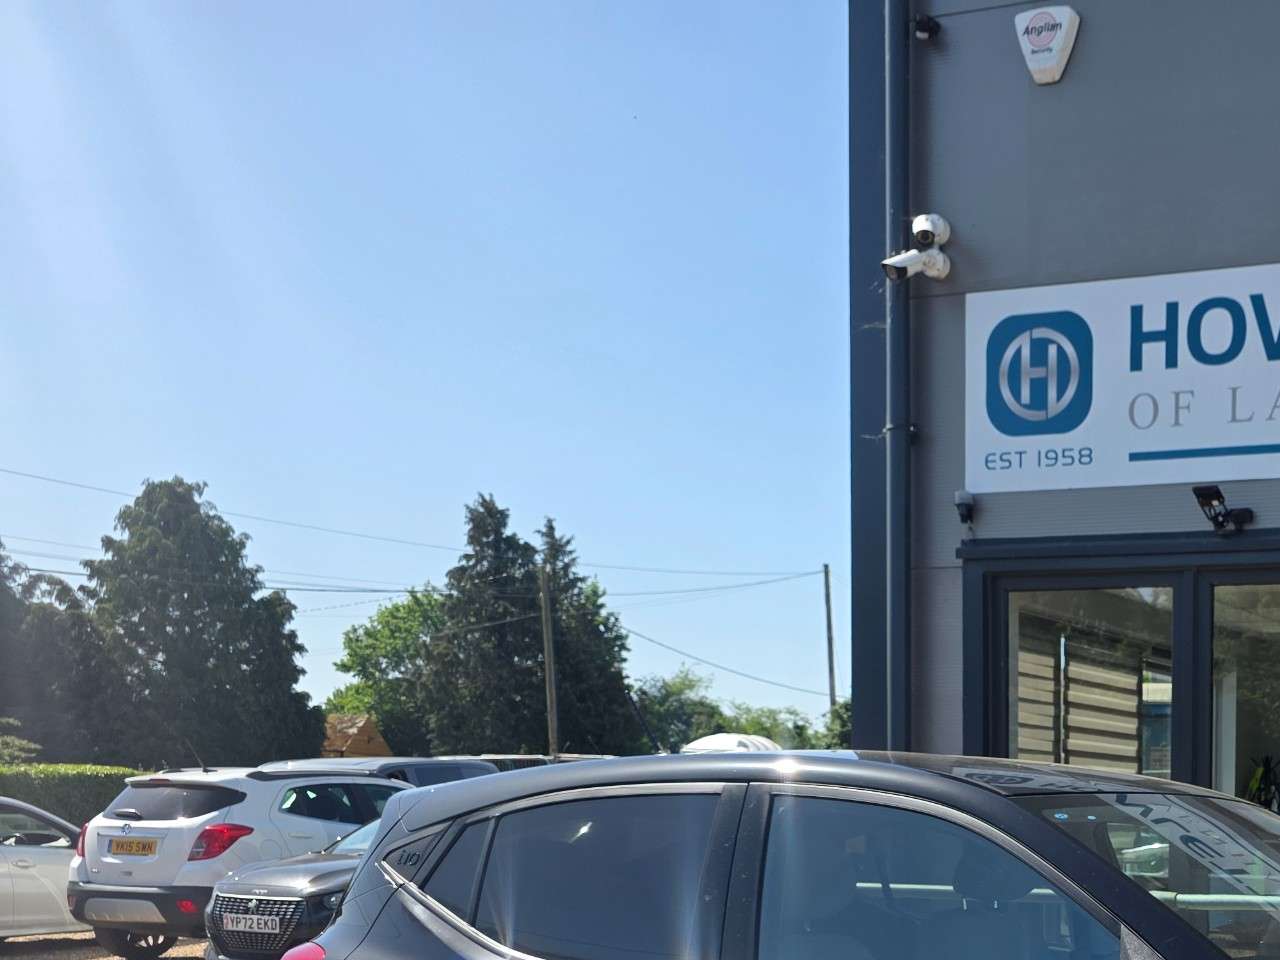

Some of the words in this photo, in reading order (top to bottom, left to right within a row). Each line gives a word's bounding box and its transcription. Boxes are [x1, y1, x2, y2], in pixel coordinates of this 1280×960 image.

[1128, 389, 1195, 431] OF
[985, 451, 1027, 470] EST
[1038, 447, 1094, 468] 1958
[229, 916, 255, 930] YP72
